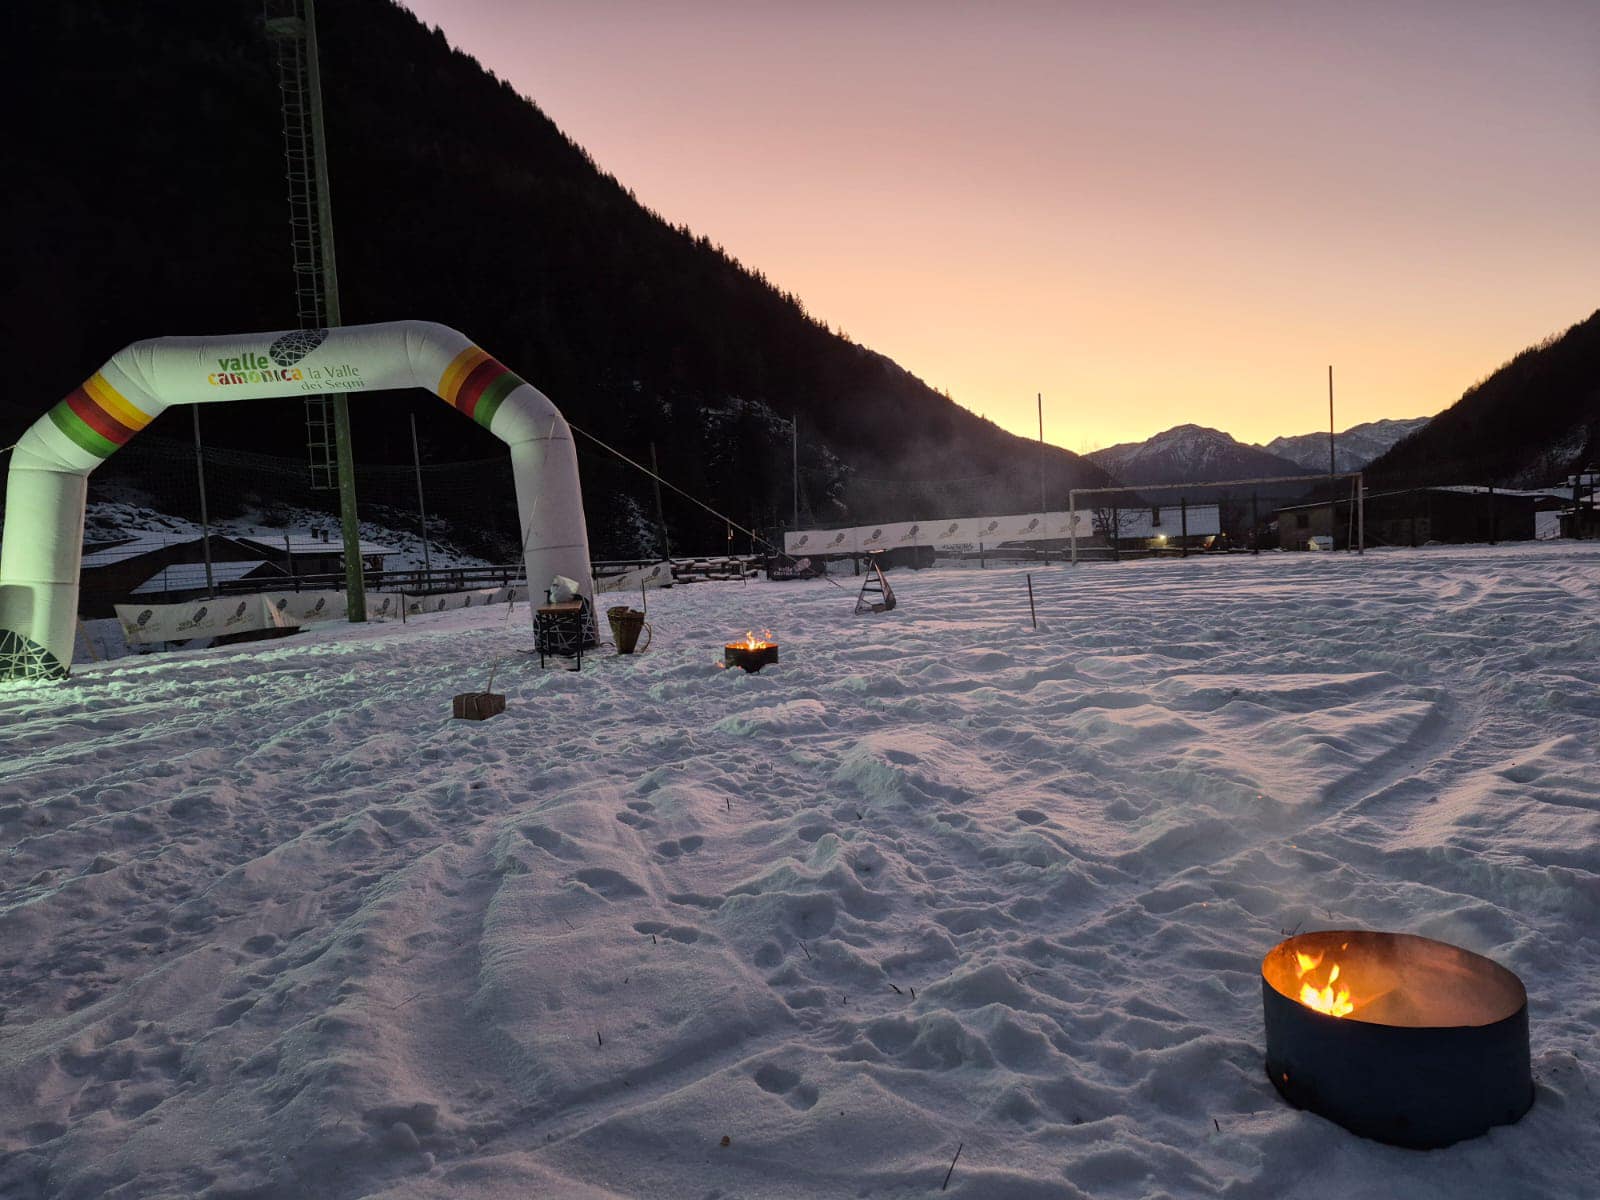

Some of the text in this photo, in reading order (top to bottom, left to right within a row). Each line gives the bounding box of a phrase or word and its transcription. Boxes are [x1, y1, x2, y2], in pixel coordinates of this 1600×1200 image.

[218, 352, 269, 371] valle
[208, 368, 303, 386] camonica
[308, 365, 360, 379] la Valle
[301, 380, 322, 391] dei
